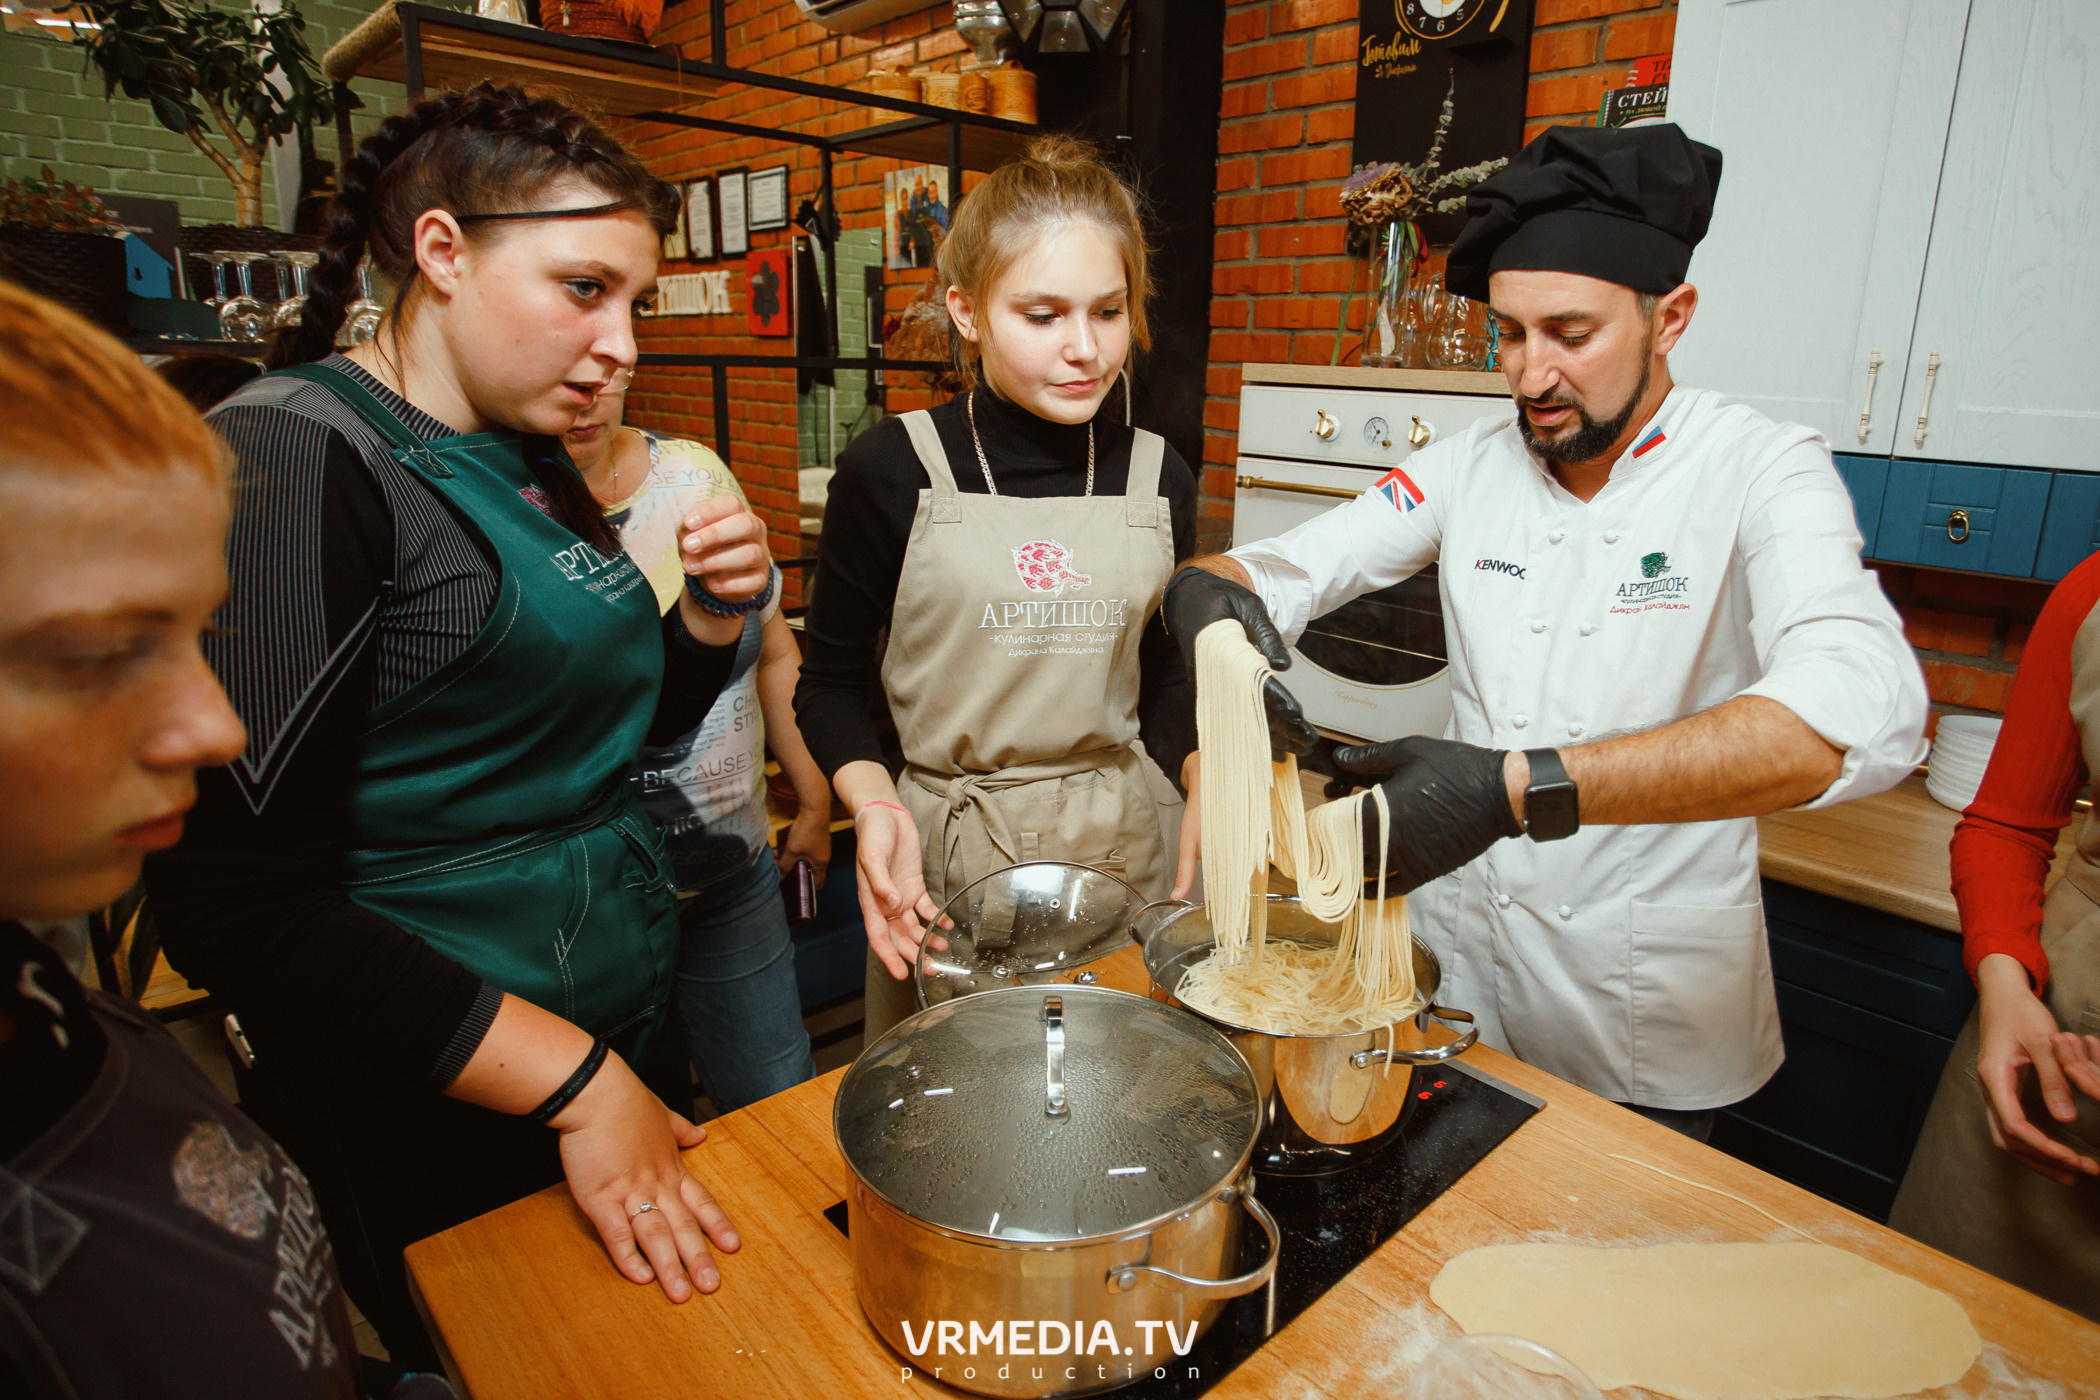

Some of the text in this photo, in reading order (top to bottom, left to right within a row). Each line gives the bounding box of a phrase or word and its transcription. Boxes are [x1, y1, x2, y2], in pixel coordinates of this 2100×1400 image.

[1406, 3, 1415, 16] 8
[1456, 8, 1465, 21] 5
[1418, 16, 1427, 29] 7
[1436, 19, 1445, 32] 6
[1617, 87, 1668, 108] СТЕЙ
[1615, 576, 1690, 599] АРТИШОК
[978, 599, 1128, 629] АРТИШОК
[643, 753, 746, 789] BECAUSE
